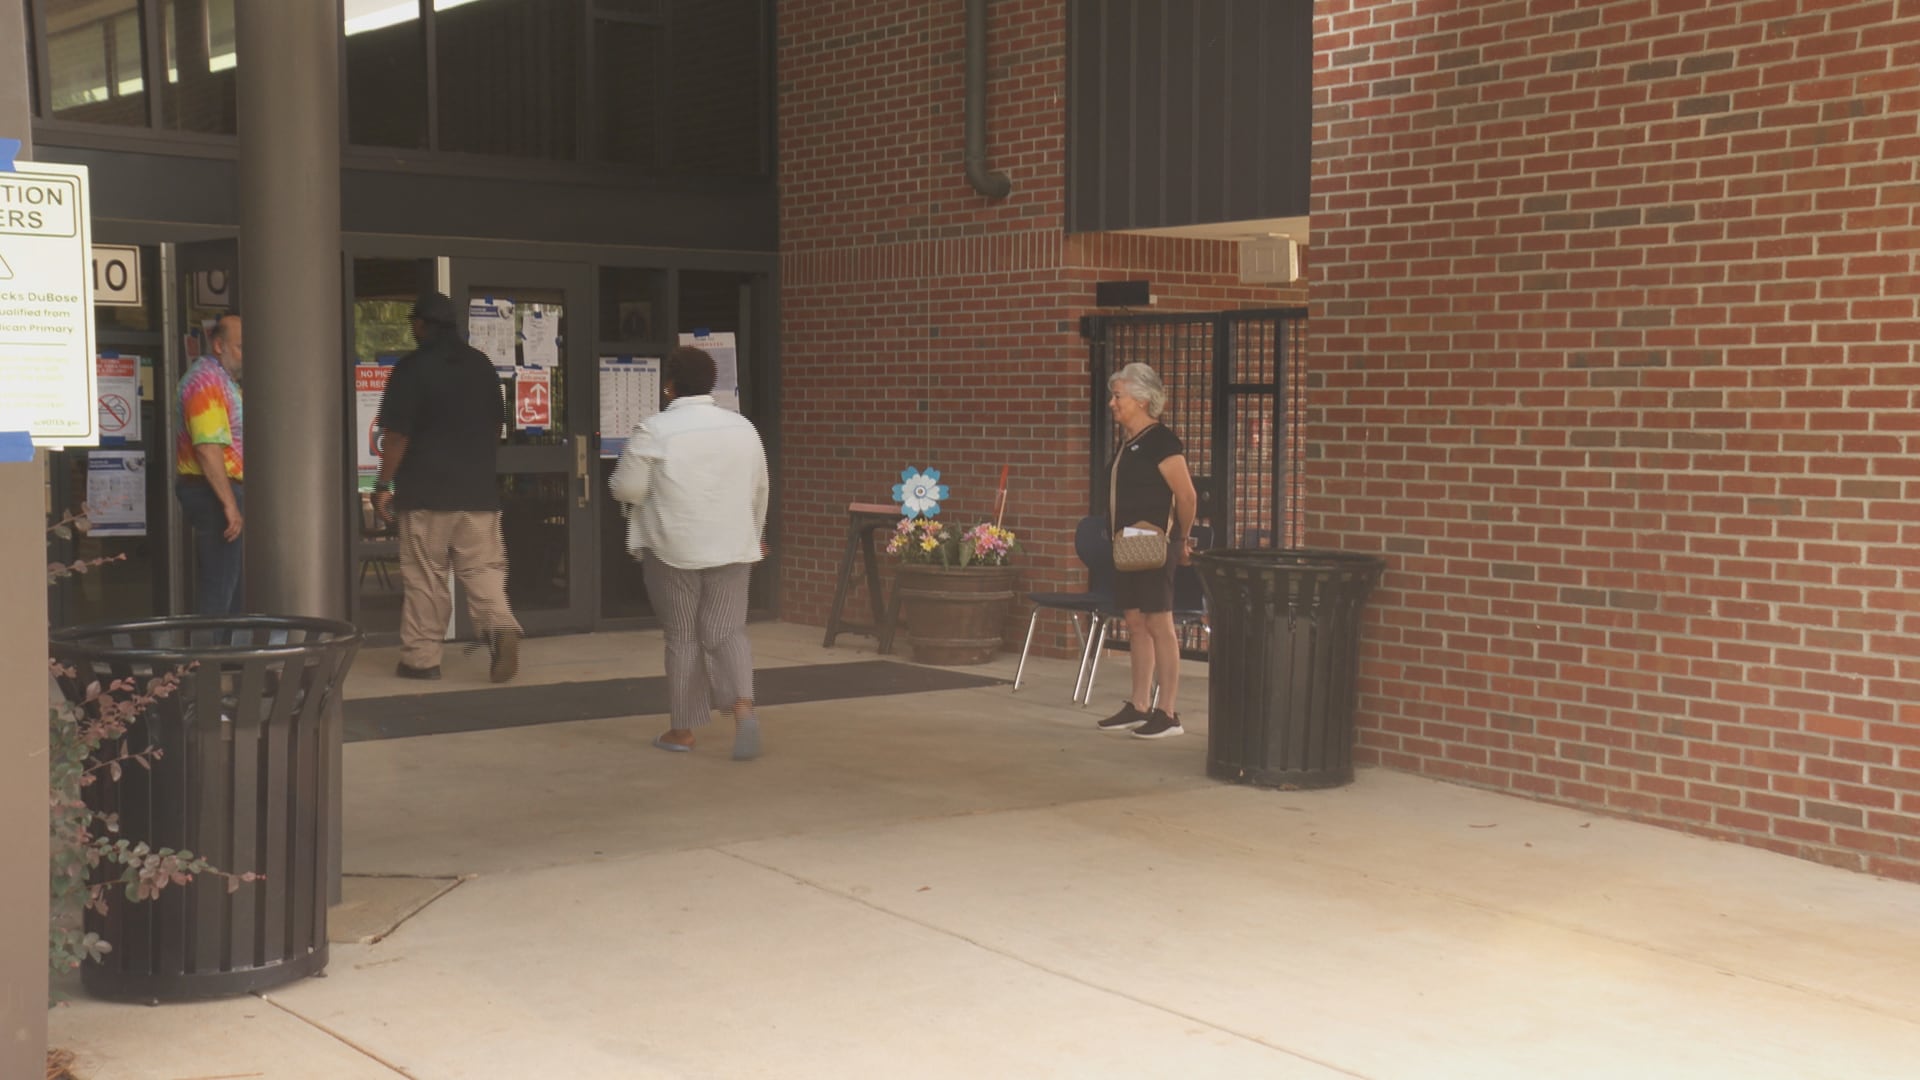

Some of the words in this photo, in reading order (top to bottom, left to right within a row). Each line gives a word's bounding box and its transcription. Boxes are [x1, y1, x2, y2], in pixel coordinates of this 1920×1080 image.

[0, 184, 63, 206] TION
[28, 292, 79, 304] DuBose
[43, 309, 71, 318] from
[29, 324, 74, 335] Primary
[361, 370, 374, 378] NO
[356, 380, 369, 388] OR
